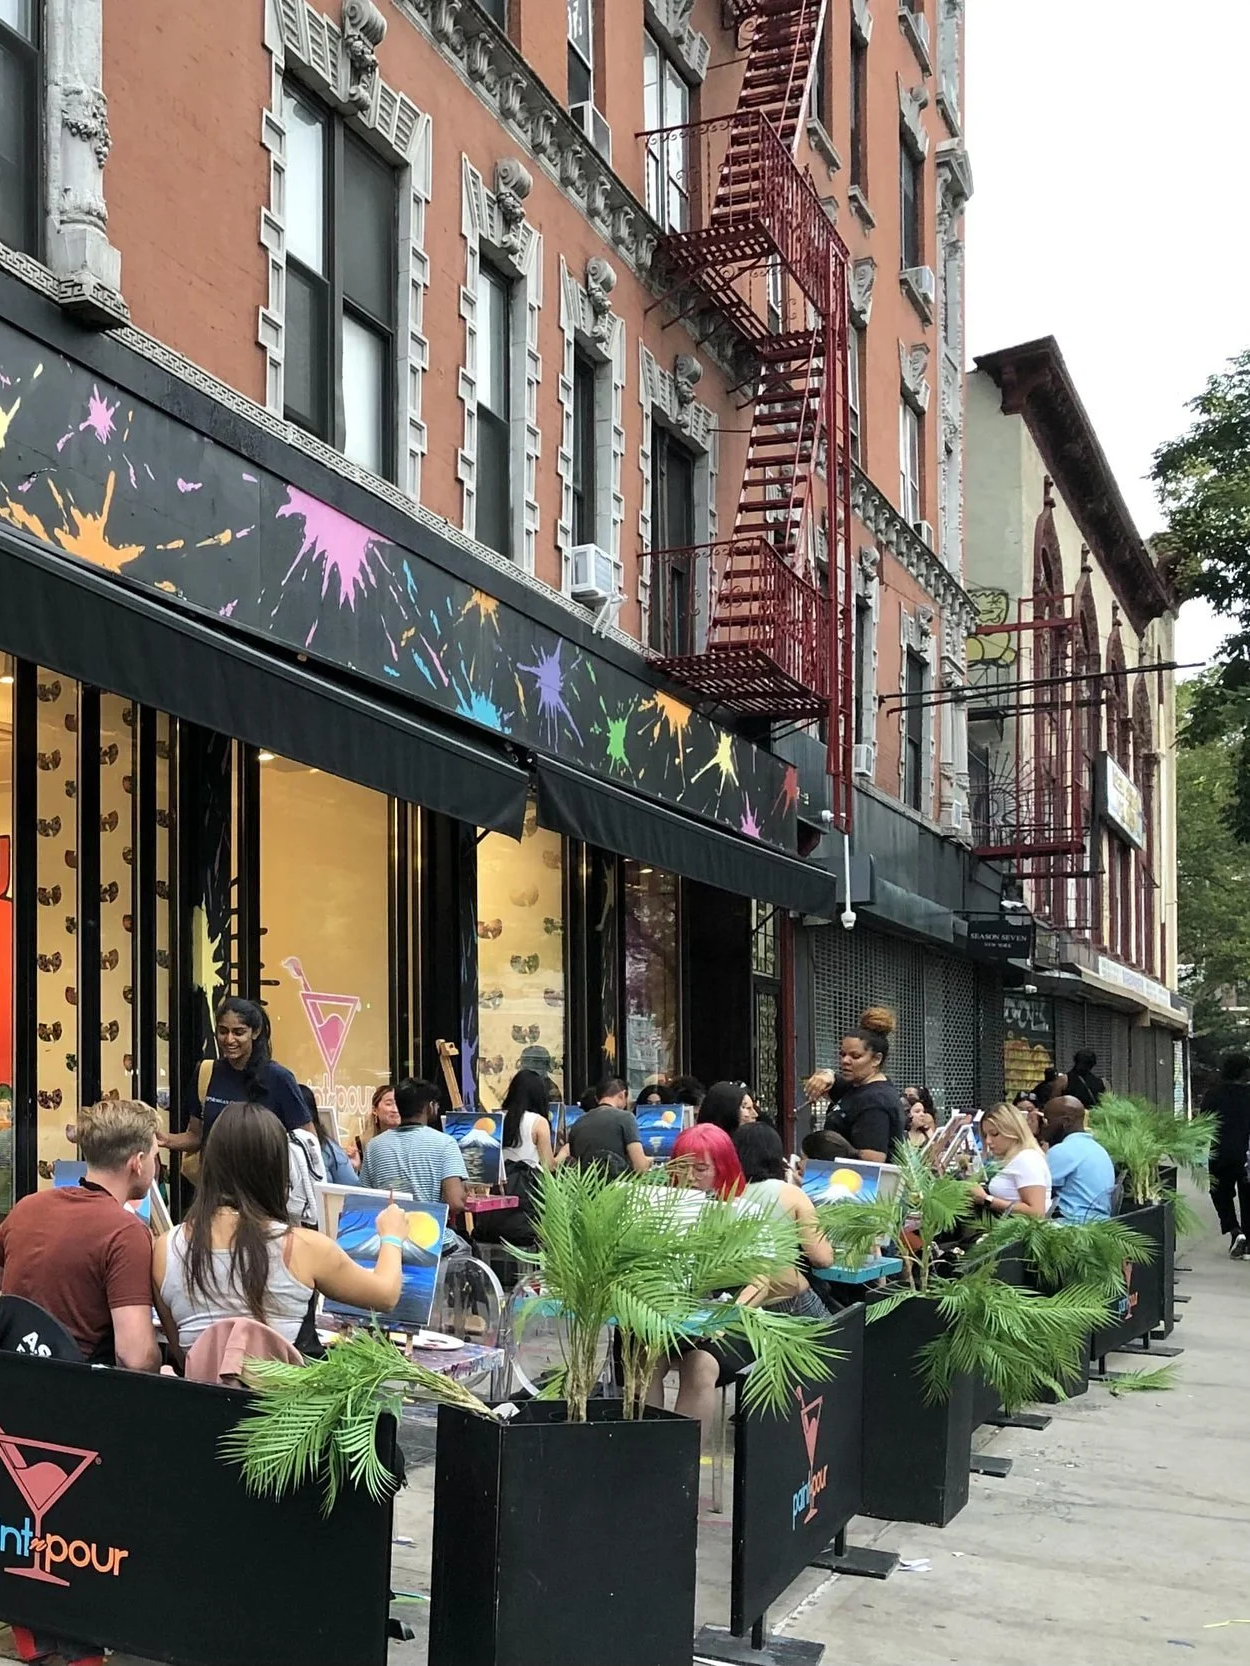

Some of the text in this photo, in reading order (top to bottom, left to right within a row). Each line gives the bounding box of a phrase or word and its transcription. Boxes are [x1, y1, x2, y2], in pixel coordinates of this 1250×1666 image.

[970, 932, 1027, 942] SEASON SEVEN
[44, 1532, 129, 1577] pour
